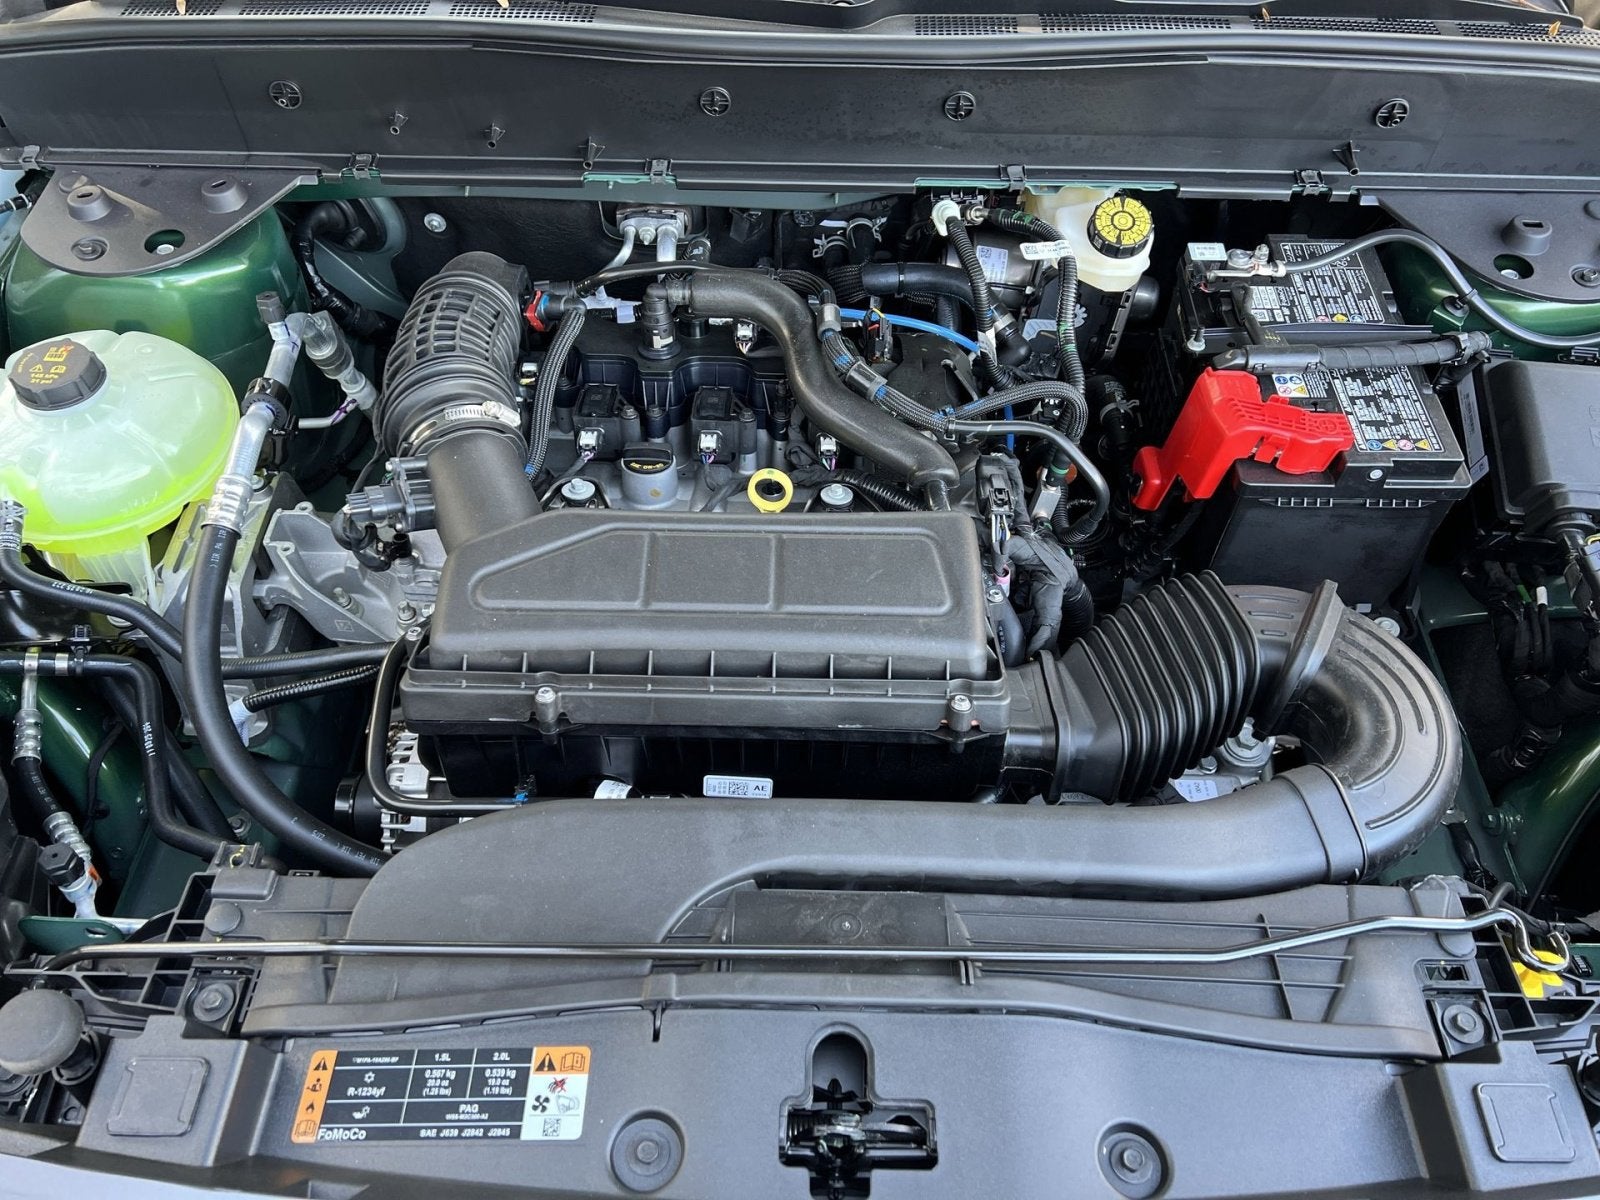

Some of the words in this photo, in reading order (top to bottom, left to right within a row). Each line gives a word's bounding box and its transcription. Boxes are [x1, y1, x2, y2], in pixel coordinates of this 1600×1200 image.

[434, 1053, 451, 1062] 1.5L
[493, 1052, 510, 1061] 2.0L
[446, 1070, 456, 1079] kg
[485, 1068, 505, 1077] 0.539
[506, 1068, 516, 1079] kg
[347, 1086, 385, 1098] R-1234yf
[459, 1103, 479, 1113] PAG
[317, 1128, 366, 1140] FoMoCo
[420, 1129, 436, 1138] SAE
[440, 1129, 459, 1138] J639
